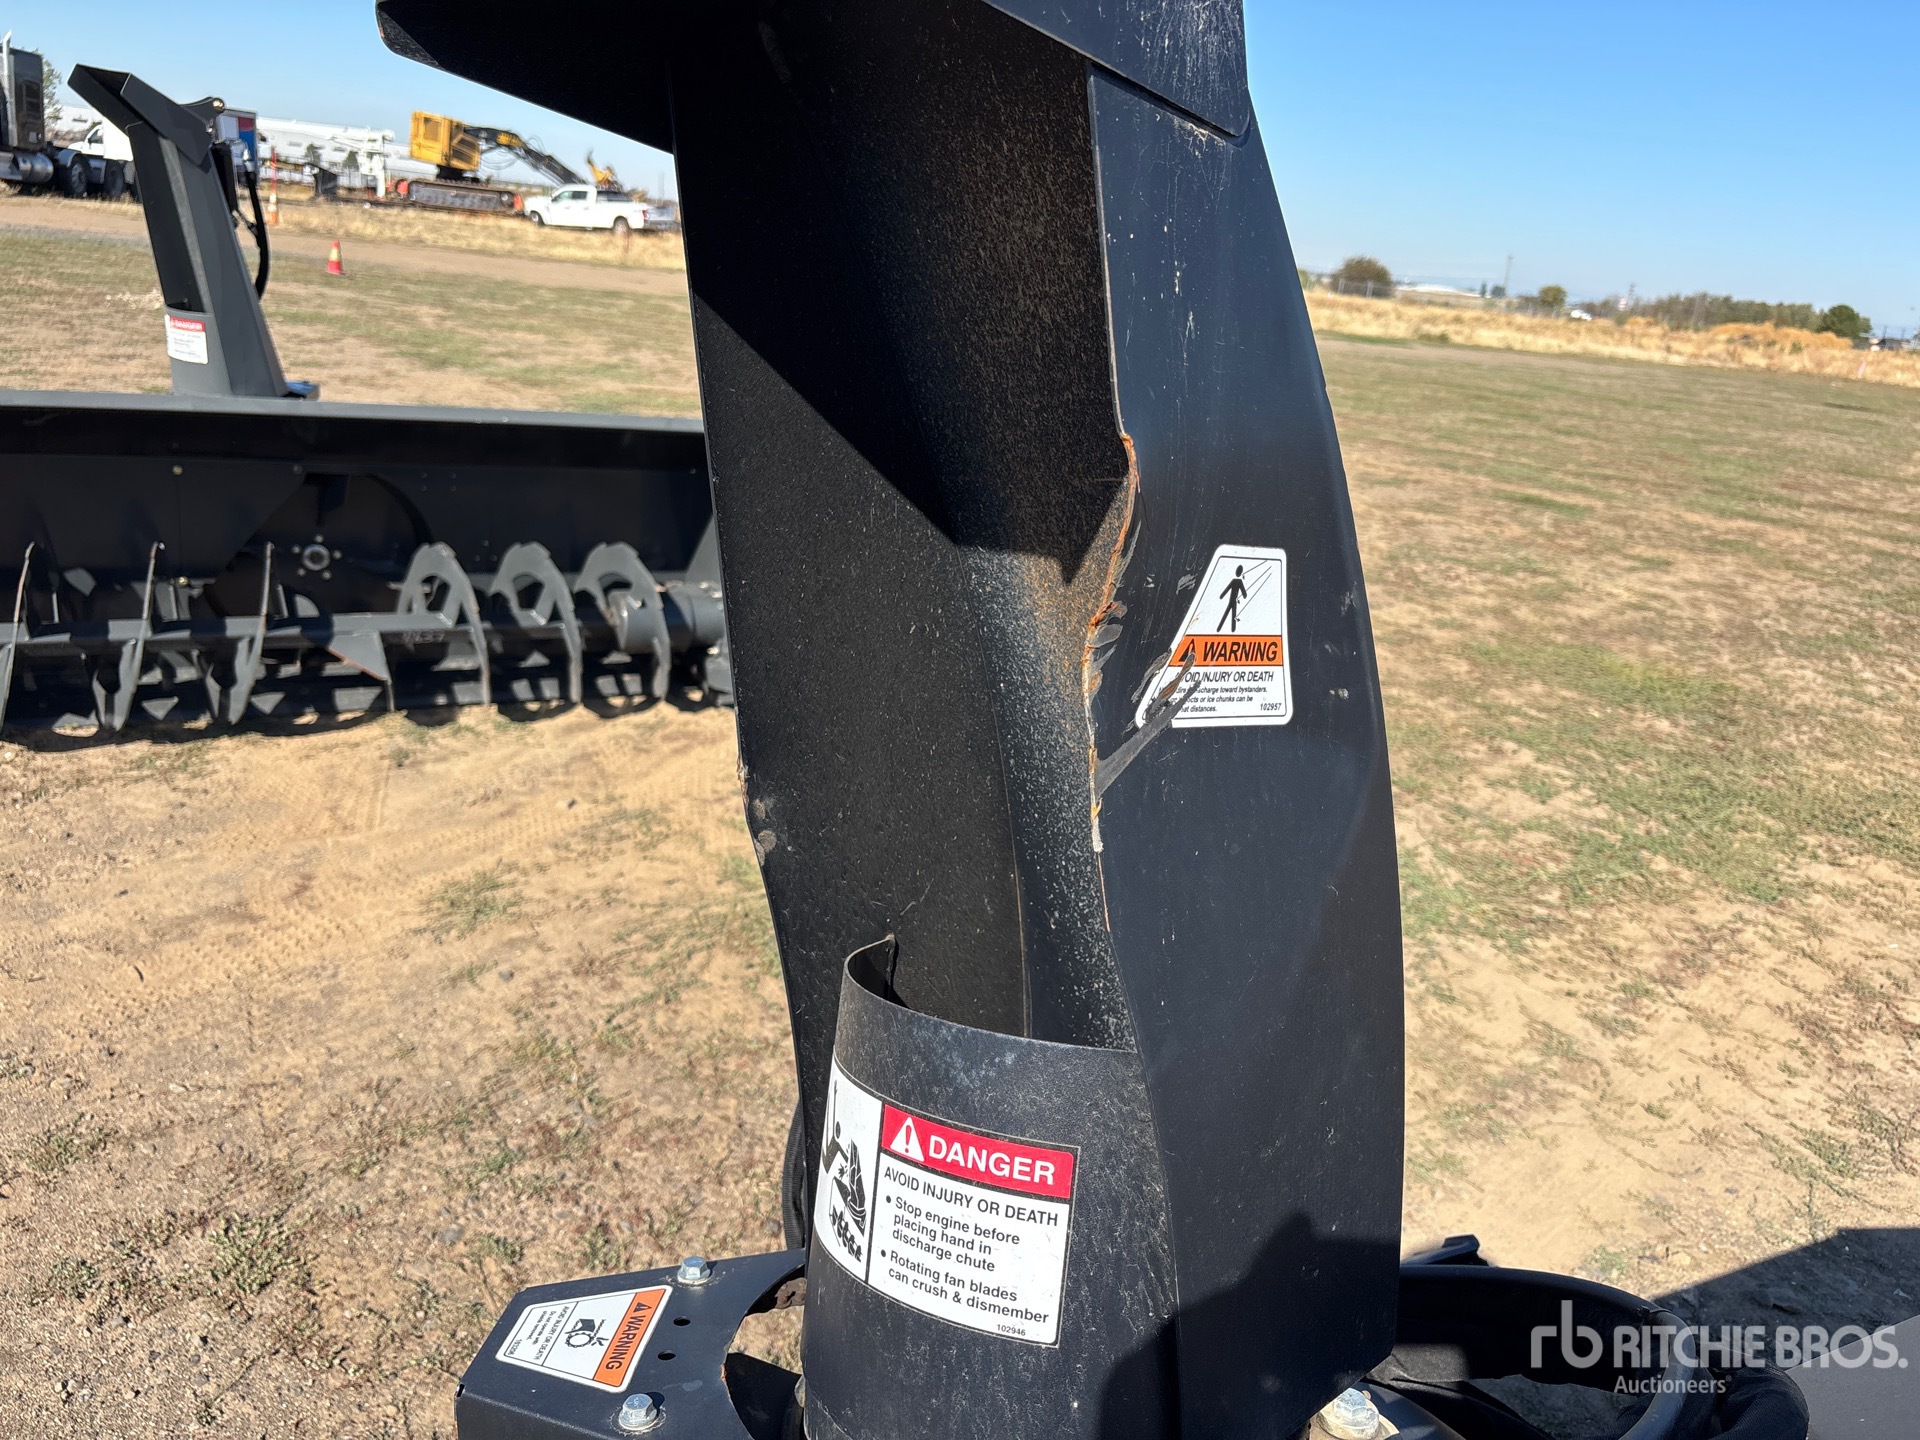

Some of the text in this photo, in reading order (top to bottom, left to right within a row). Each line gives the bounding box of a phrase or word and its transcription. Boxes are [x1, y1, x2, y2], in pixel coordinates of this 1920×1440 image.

[1202, 641, 1278, 662] WARNING
[1175, 671, 1274, 683] OID INJURY OR DEATH
[1219, 686, 1238, 694] toward
[1238, 686, 1268, 695] bystanders.
[1189, 705, 1218, 713] distances.
[1215, 695, 1235, 703] chunks
[1259, 702, 1282, 711] 102957
[928, 1134, 1056, 1185] DANGER
[884, 1166, 1058, 1227] AVOID INJURY OR DEATH
[893, 1213, 992, 1255] placing hand in
[895, 1196, 1020, 1245] Stop engine before
[892, 1228, 996, 1272] discharge chute
[890, 1249, 1018, 1302] Rotating fan blades
[888, 1268, 1049, 1323] can crush & dismember
[605, 1315, 646, 1370] WARNING
[996, 1324, 1026, 1337] 102946
[533, 1344, 548, 1360] DEATH
